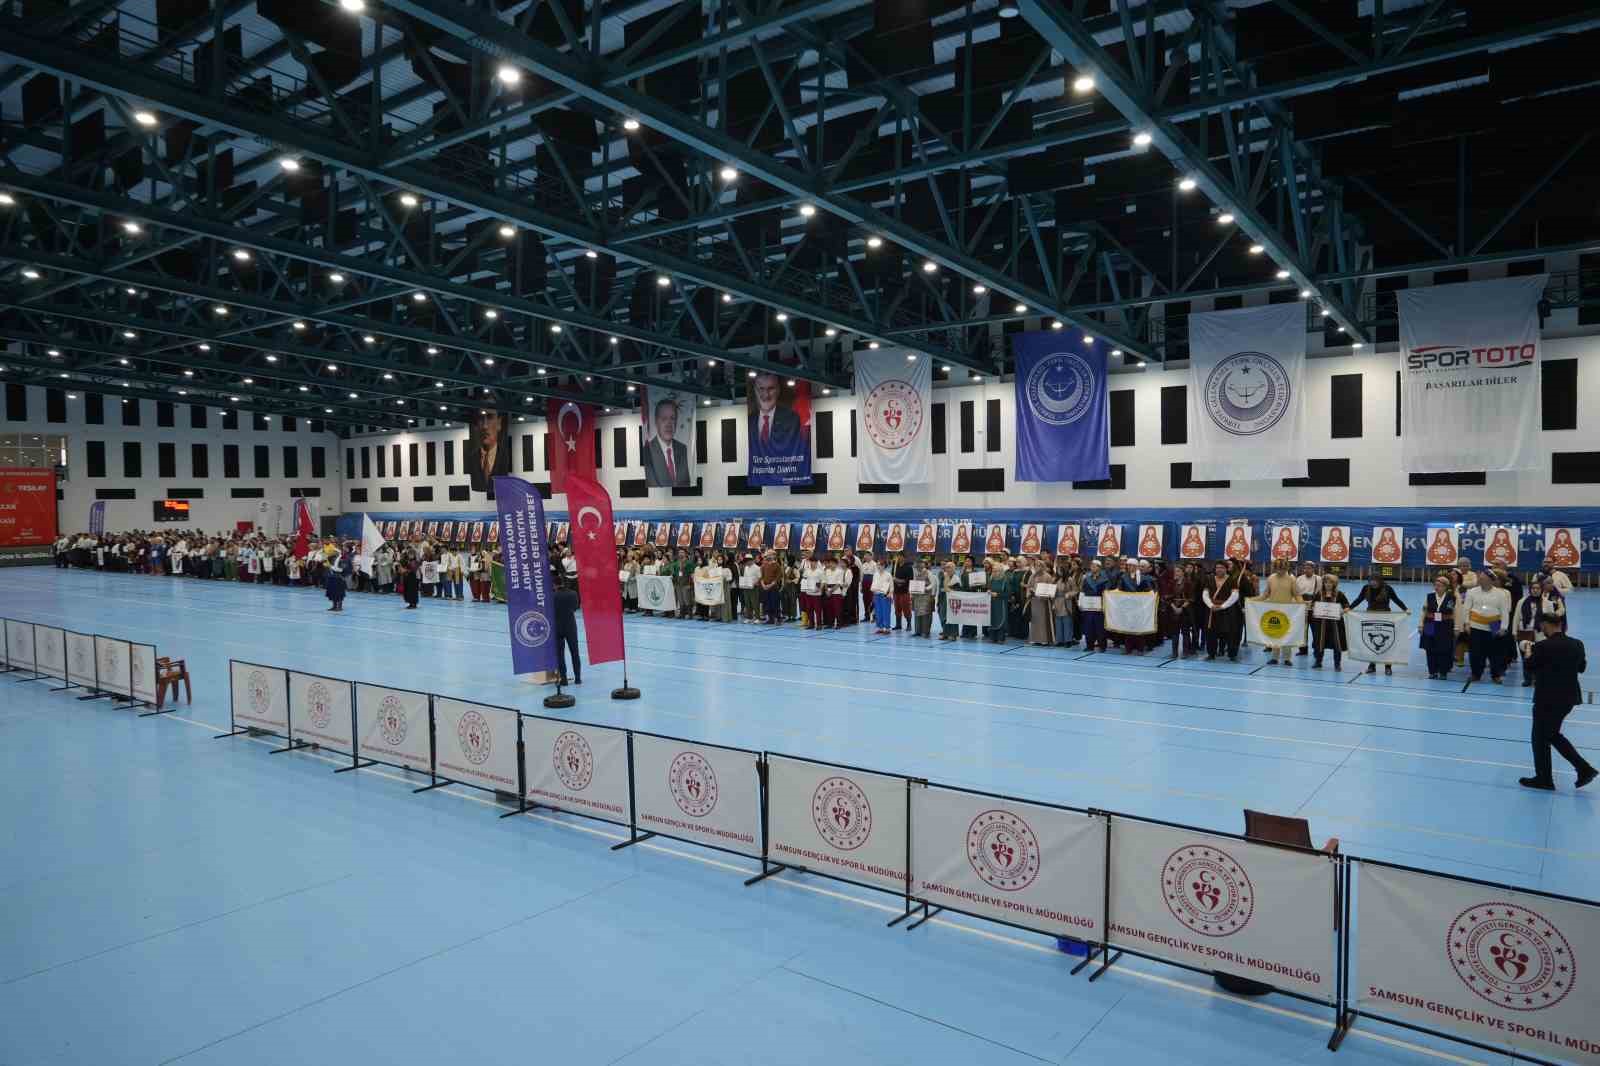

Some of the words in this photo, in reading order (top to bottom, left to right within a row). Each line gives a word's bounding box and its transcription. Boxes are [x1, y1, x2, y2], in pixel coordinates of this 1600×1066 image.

[1408, 350, 1470, 369] SPOR
[1472, 344, 1536, 364] TOTO
[775, 843, 802, 856] SAMSUN
[802, 850, 831, 864] GENÇLİK
[840, 859, 859, 870] SPOR
[922, 880, 955, 896] SAMSUN
[956, 889, 990, 905] GENÇLİK
[990, 898, 1001, 908] VE
[1002, 900, 1025, 913] SPOR
[1034, 907, 1094, 929] MÜDÜRLÜĞÜ
[1108, 923, 1146, 940] AMSUN
[1146, 932, 1191, 952] GENÇLİK
[1191, 944, 1205, 955] VE
[1206, 947, 1234, 962] SPOR
[1235, 952, 1246, 966] İL
[1246, 956, 1322, 984] MÜDÜRLÜĞÜ
[1368, 986, 1425, 1009] SAMSUN
[1426, 1001, 1486, 1025] GENÇLİK
[1486, 1016, 1505, 1030] VE
[1507, 1022, 1546, 1041] SPOR
[1548, 1030, 1562, 1045] İL
